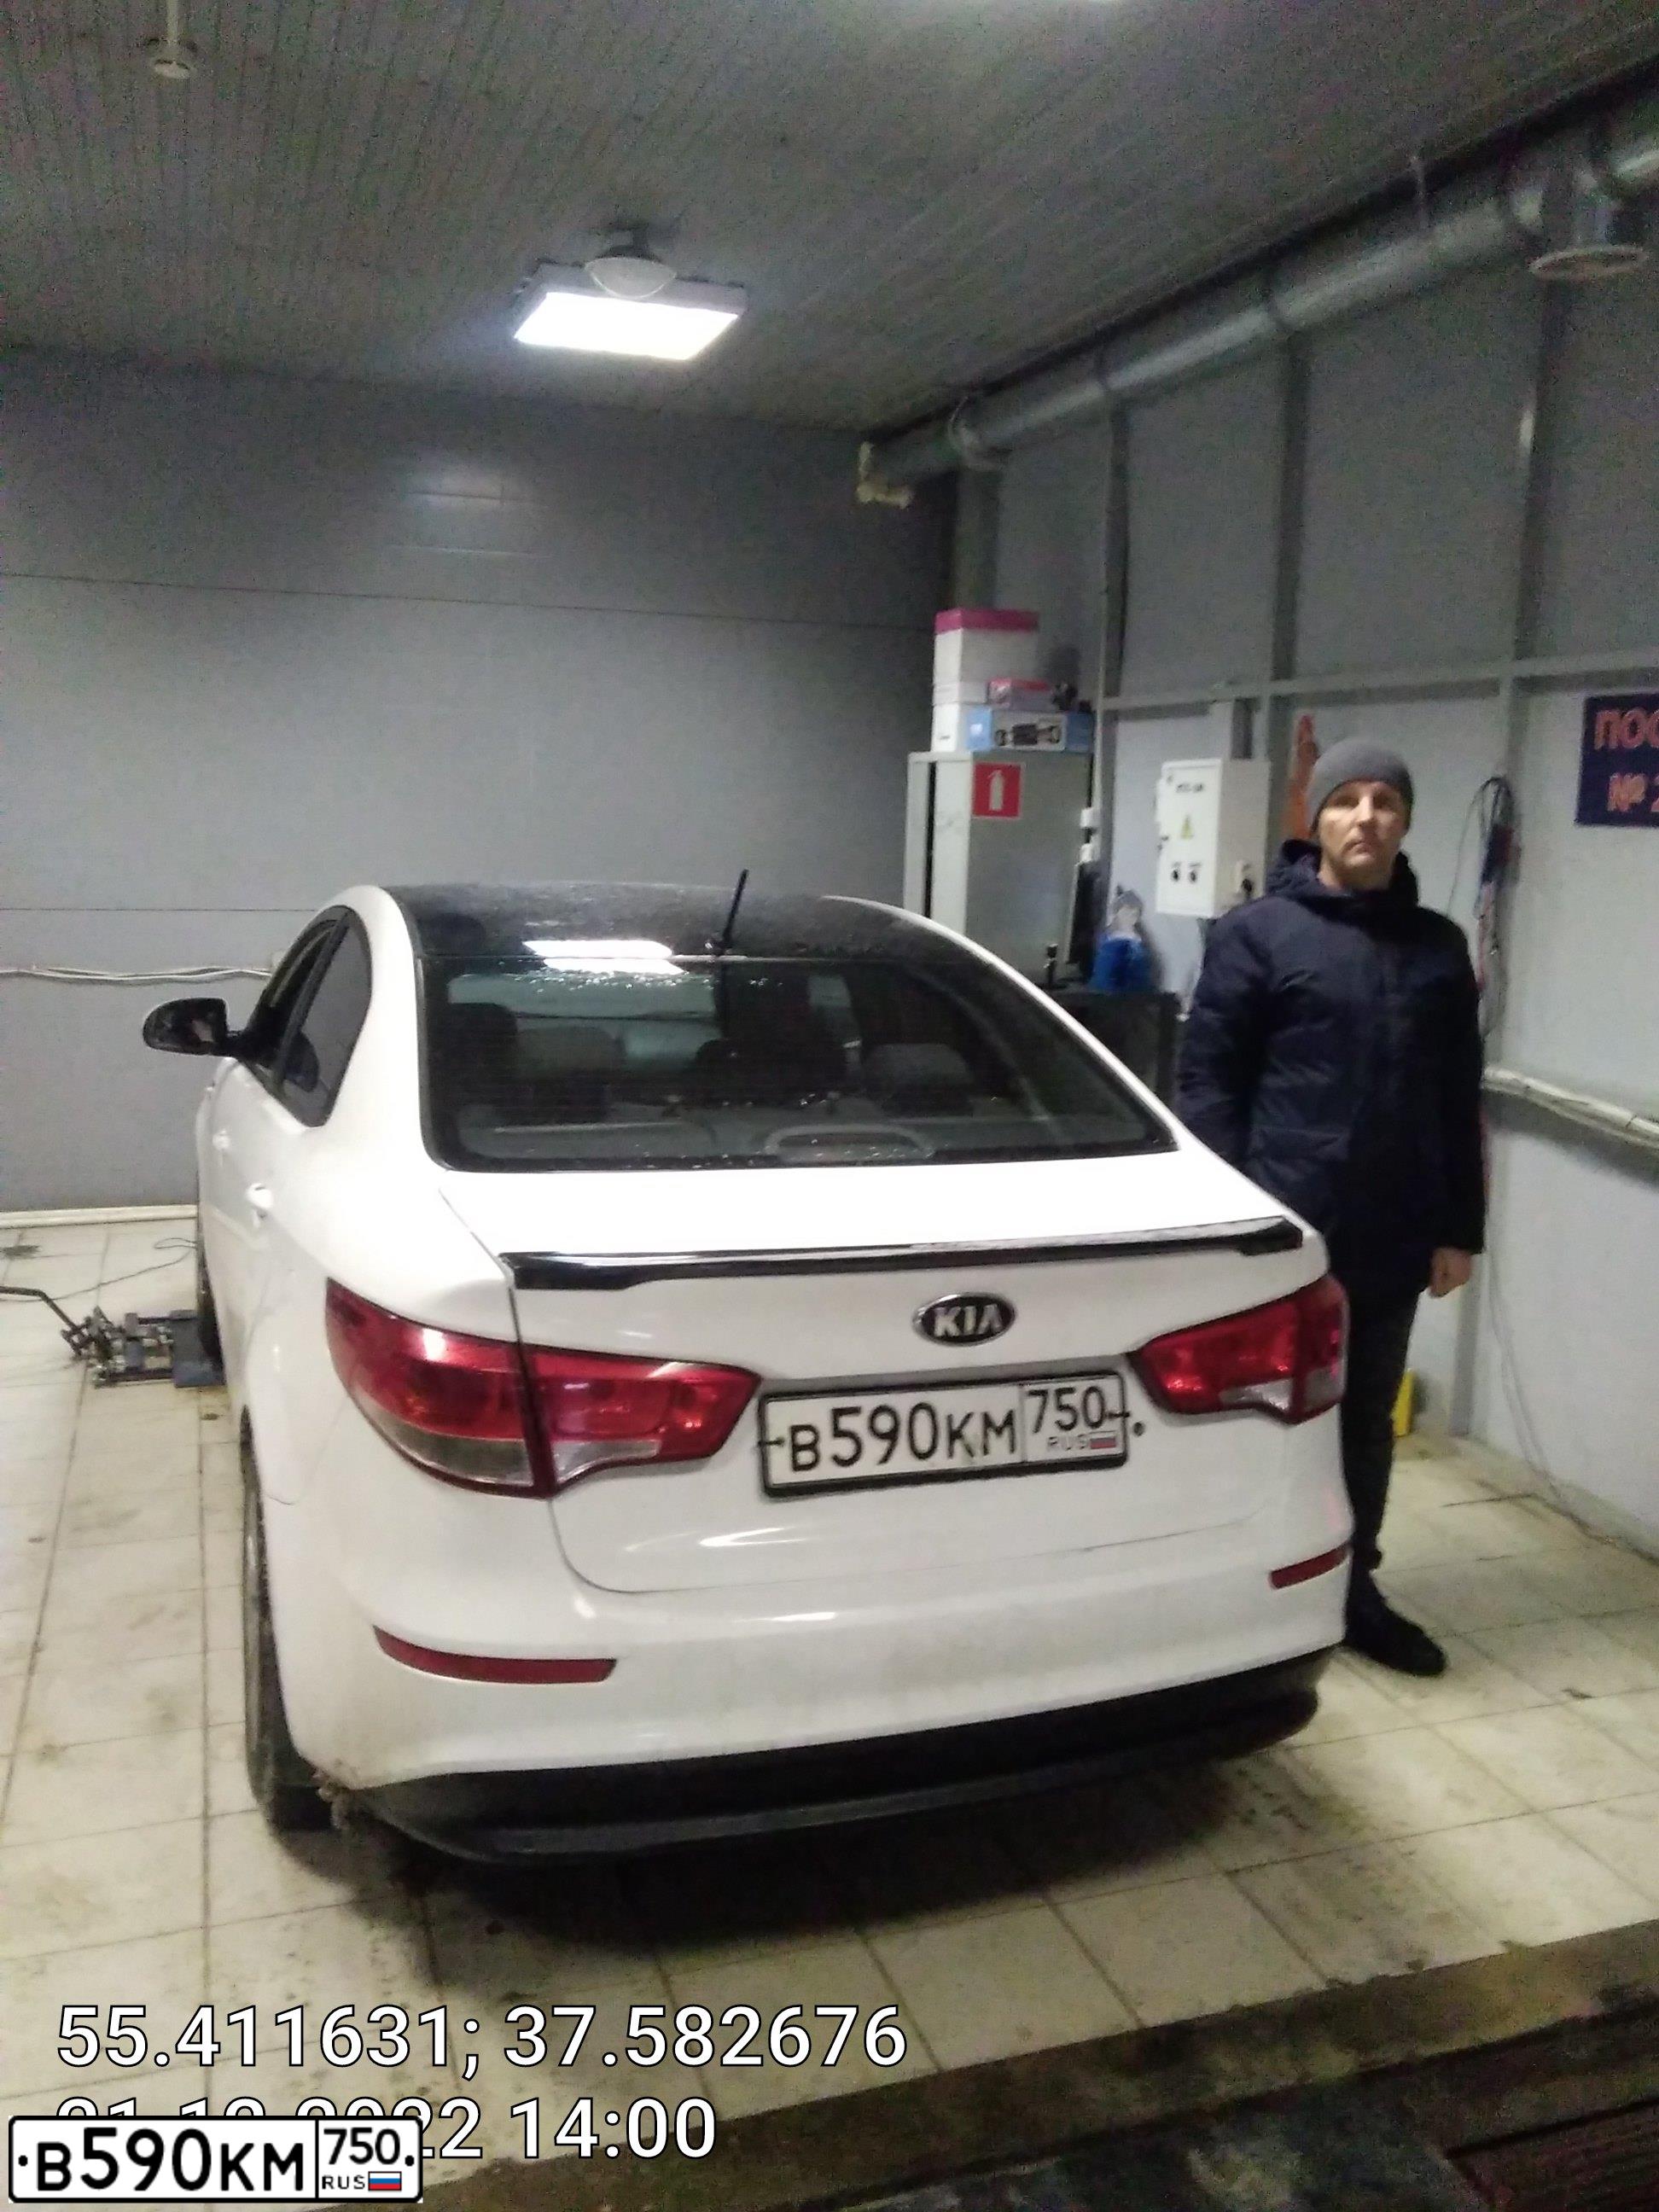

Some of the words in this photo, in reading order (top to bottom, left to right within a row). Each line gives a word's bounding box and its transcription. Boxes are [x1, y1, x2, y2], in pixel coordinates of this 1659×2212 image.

[933, 1303, 1004, 1338] KIA
[1027, 1385, 1107, 1435] 750
[1047, 1433, 1088, 1452] RUS
